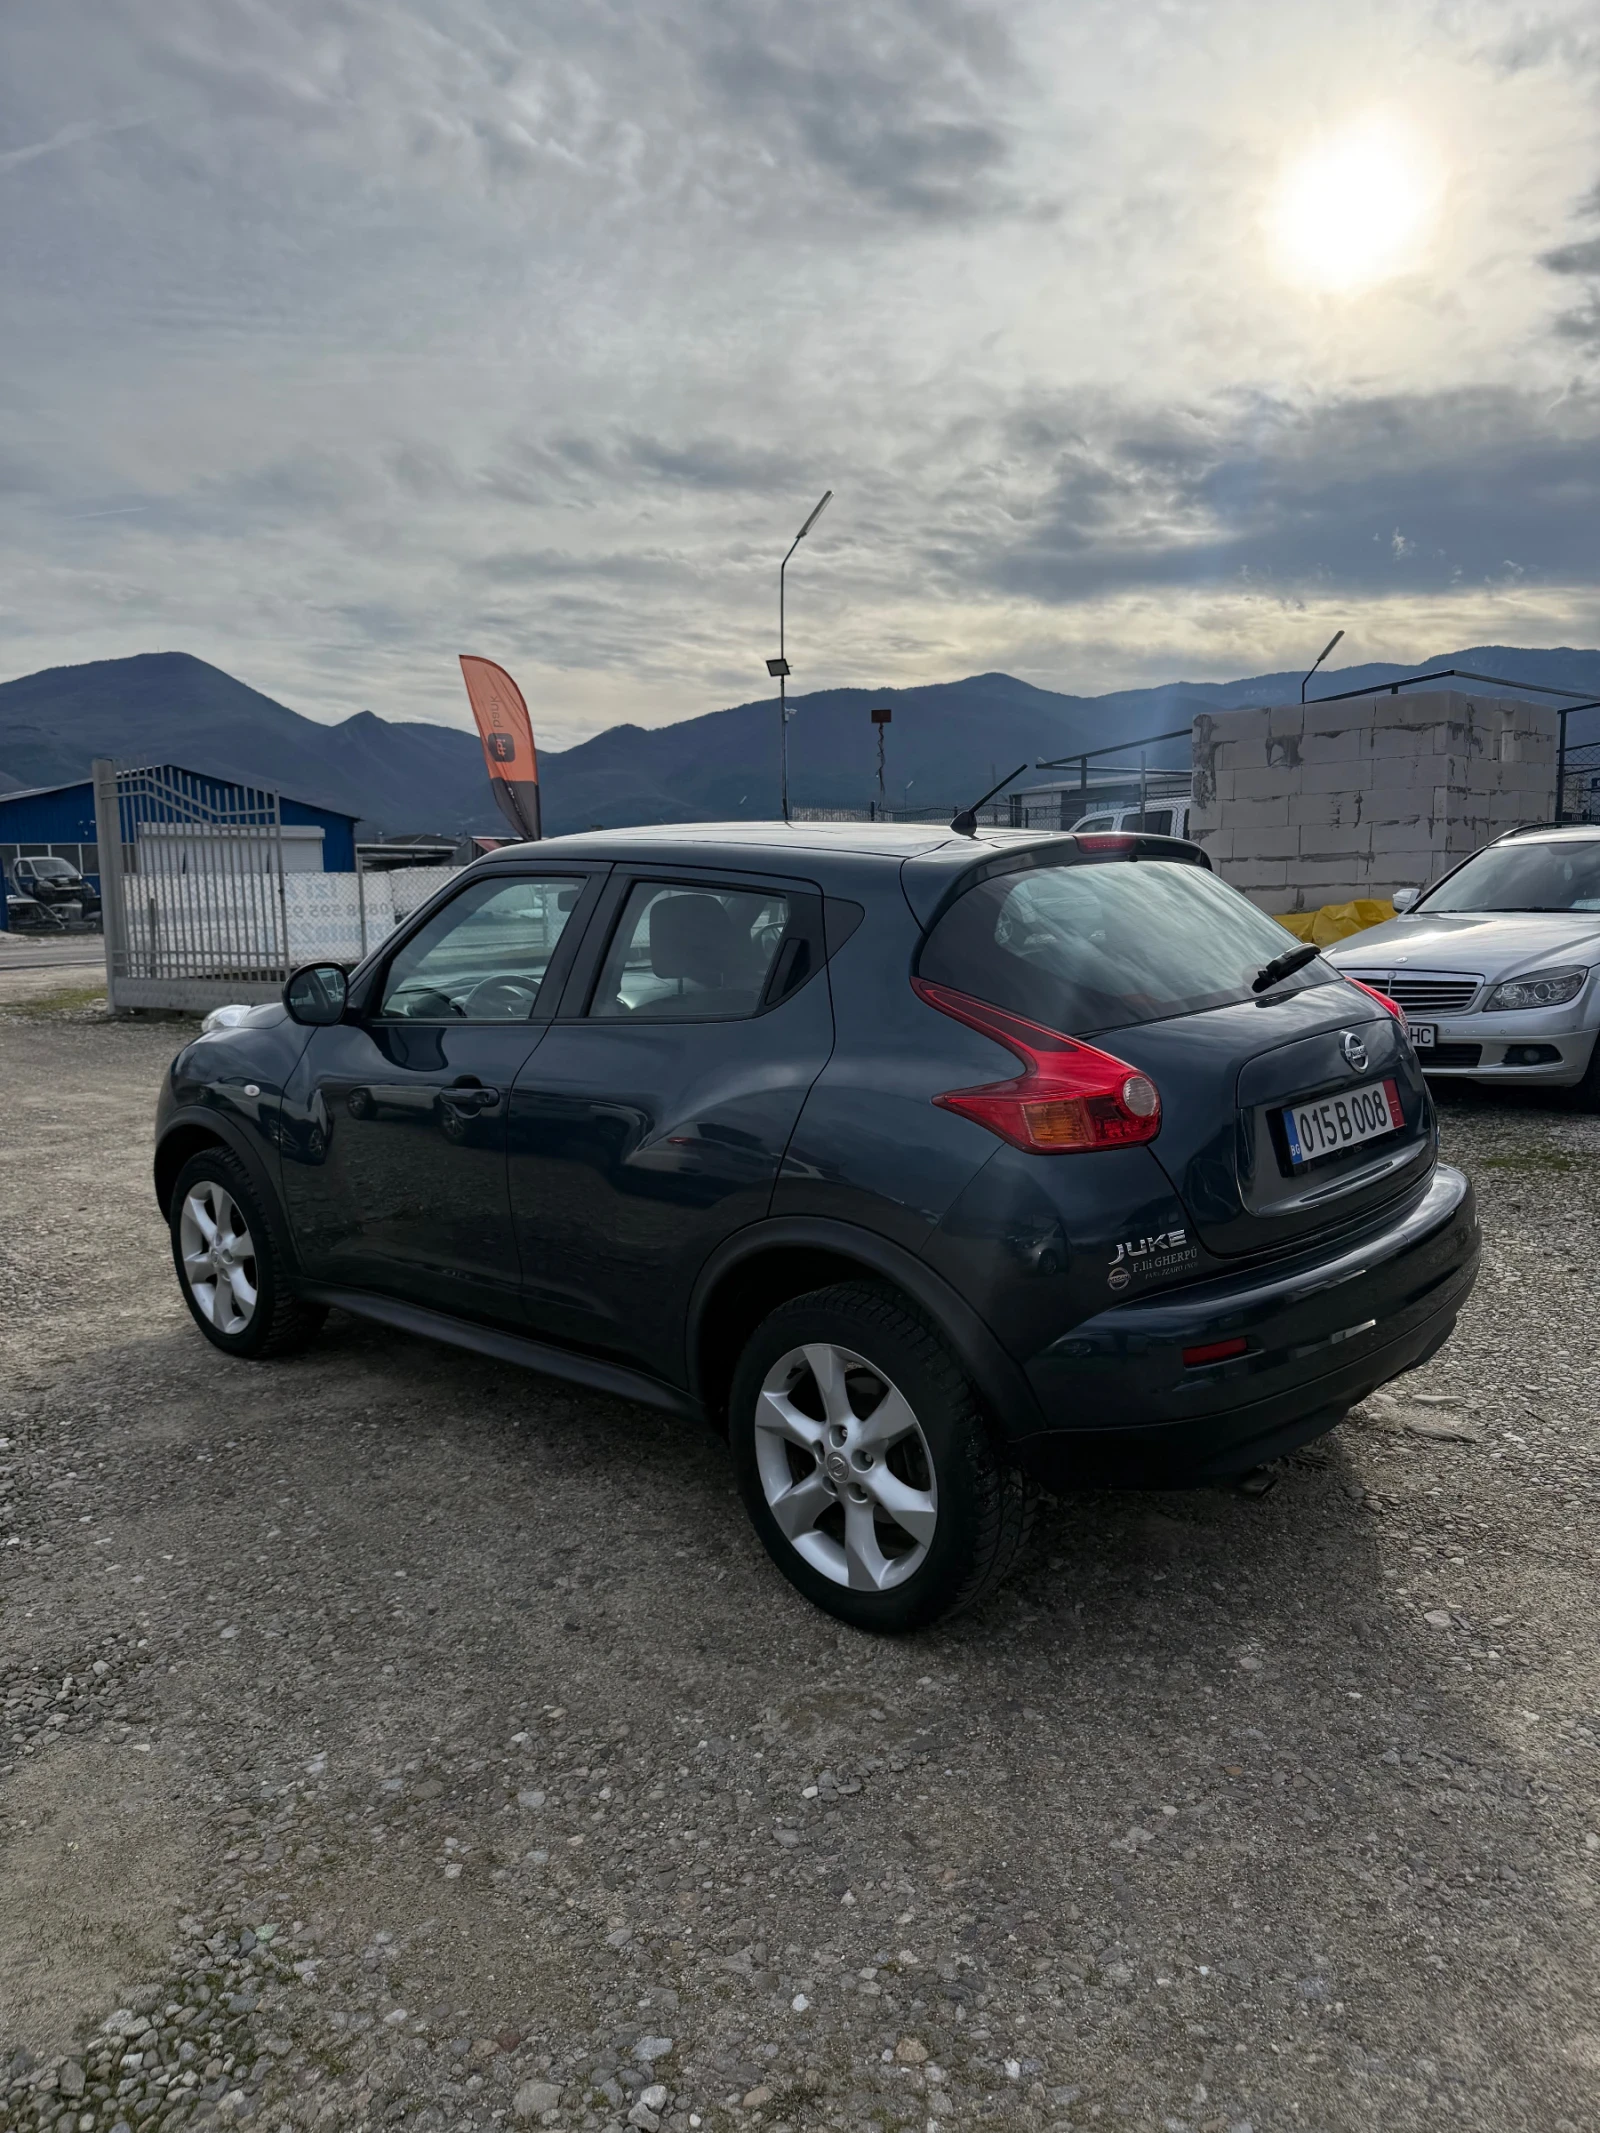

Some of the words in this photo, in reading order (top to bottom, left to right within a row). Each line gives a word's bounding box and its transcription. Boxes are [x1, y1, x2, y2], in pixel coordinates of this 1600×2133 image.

[1409, 1028, 1432, 1044] HC
[1299, 1090, 1388, 1153] 015B008
[1291, 1144, 1301, 1156] BG
[1108, 1229, 1187, 1265] JUKE
